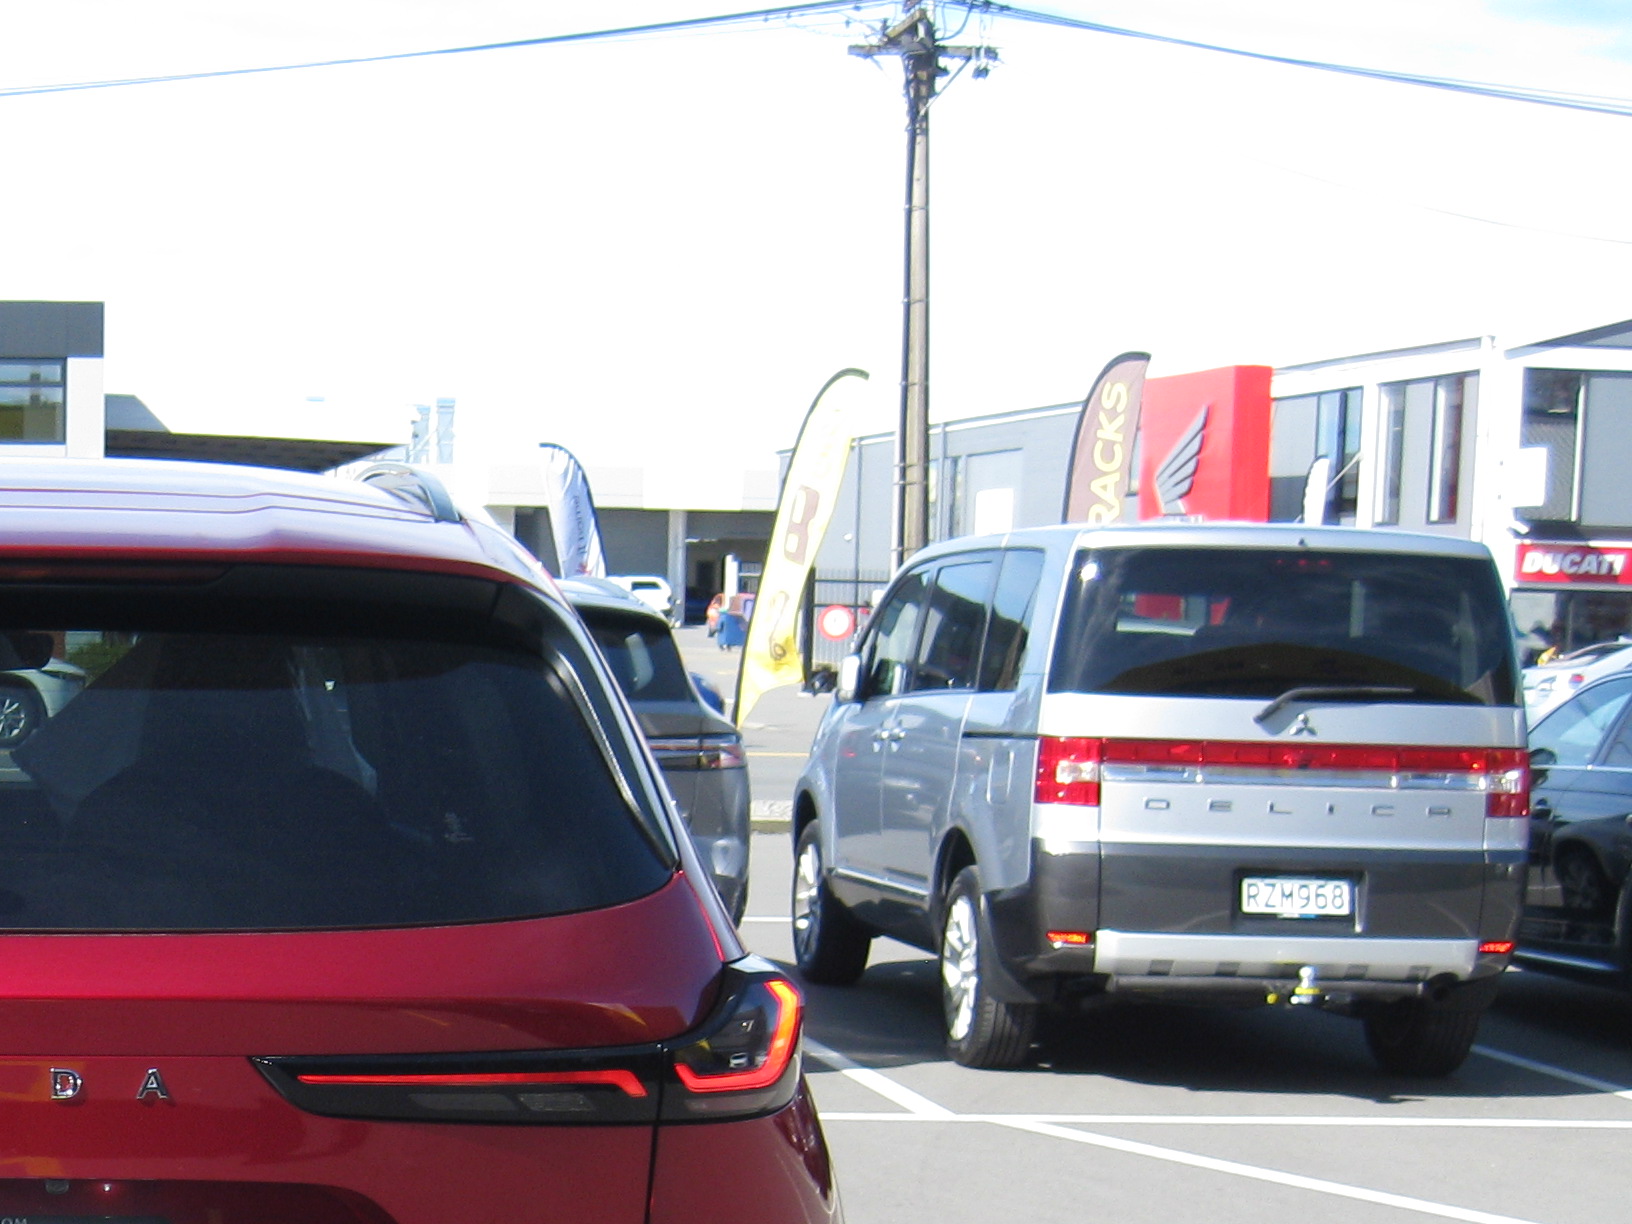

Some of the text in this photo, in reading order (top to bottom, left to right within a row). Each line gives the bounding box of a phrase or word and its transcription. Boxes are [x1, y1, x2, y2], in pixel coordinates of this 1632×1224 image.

[1521, 551, 1625, 576] DUCATI
[1144, 797, 1451, 817] DELICA
[1247, 883, 1344, 909] RZM968
